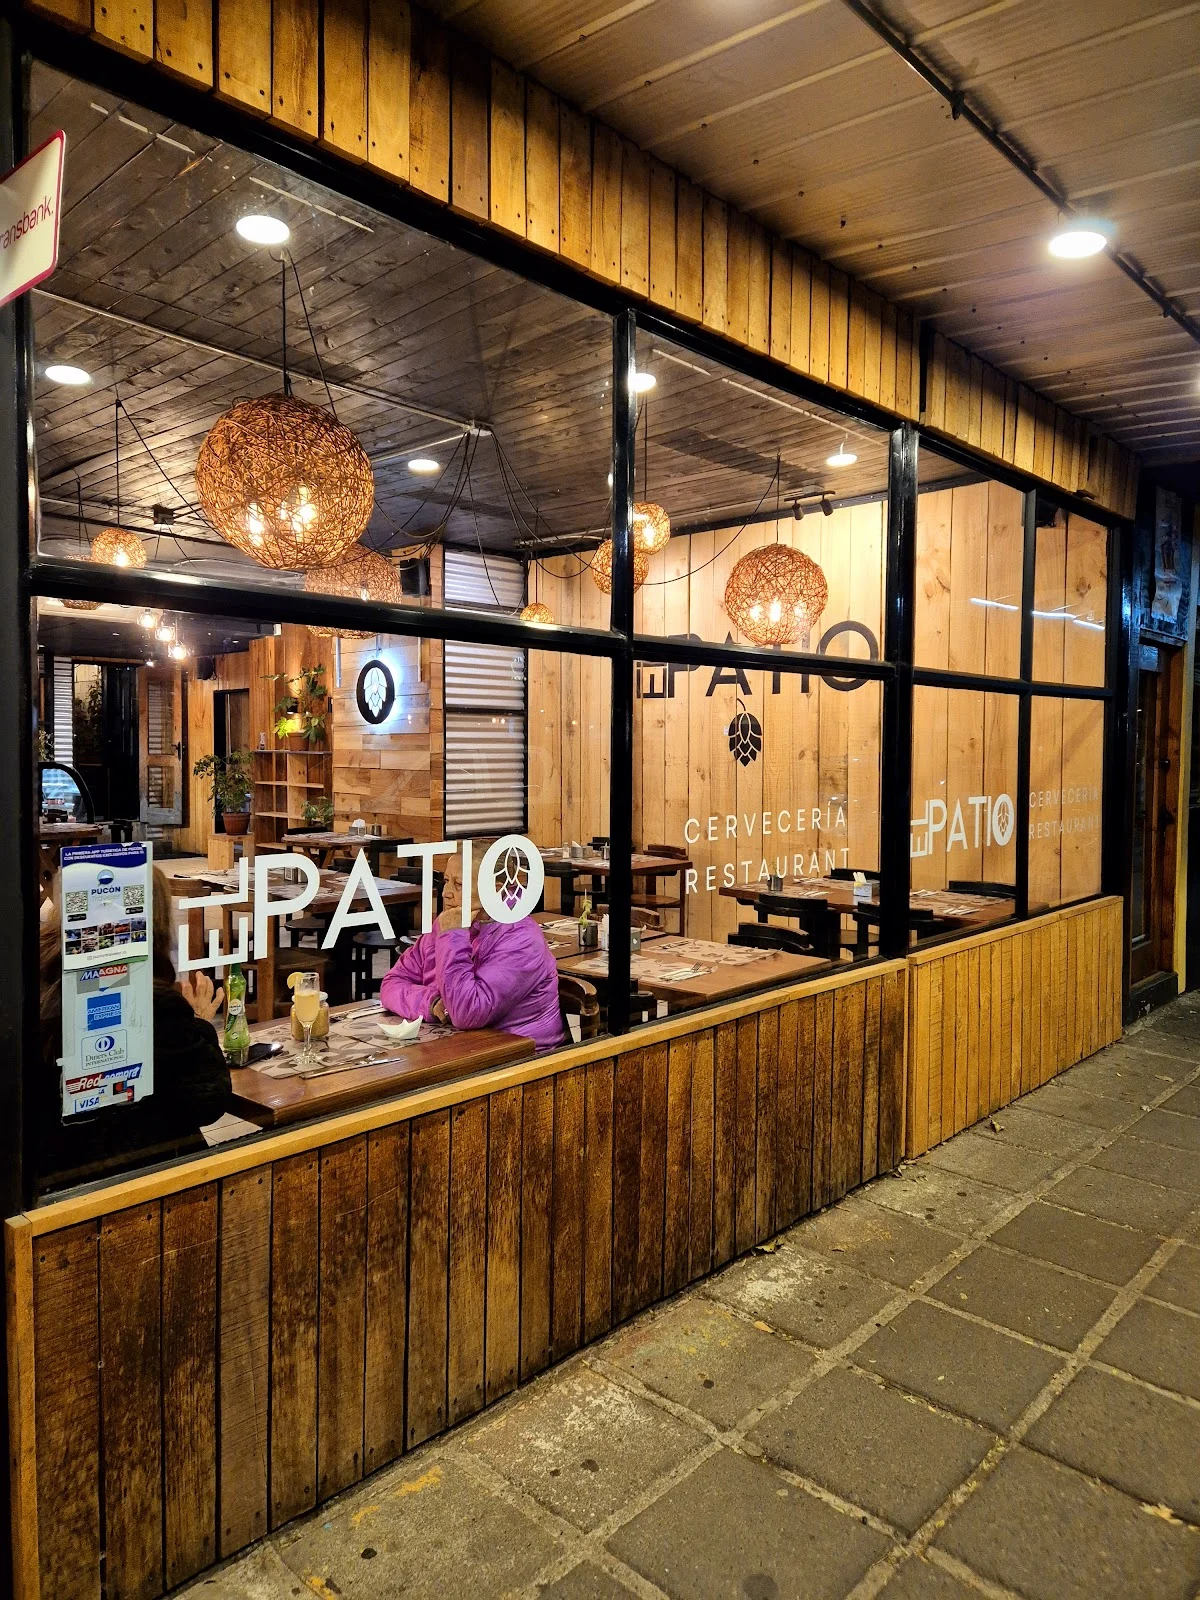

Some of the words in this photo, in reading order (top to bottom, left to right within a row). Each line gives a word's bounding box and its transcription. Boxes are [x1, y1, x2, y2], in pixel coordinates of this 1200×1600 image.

[684, 800, 847, 844] CERVECERÍA
[929, 794, 1015, 854] PATIO
[685, 848, 850, 895] RESTAURANT
[91, 886, 121, 895] PUCÓN
[178, 857, 249, 973] EL
[253, 834, 545, 961] PATIO
[88, 1003, 121, 1015] AMERICAN
[94, 1010, 122, 1020] EXPRESS
[86, 1053, 108, 1062] Diners
[109, 1048, 124, 1056] Club
[86, 1055, 124, 1067] INTERNATIONAL
[80, 1097, 100, 1108] VISA
